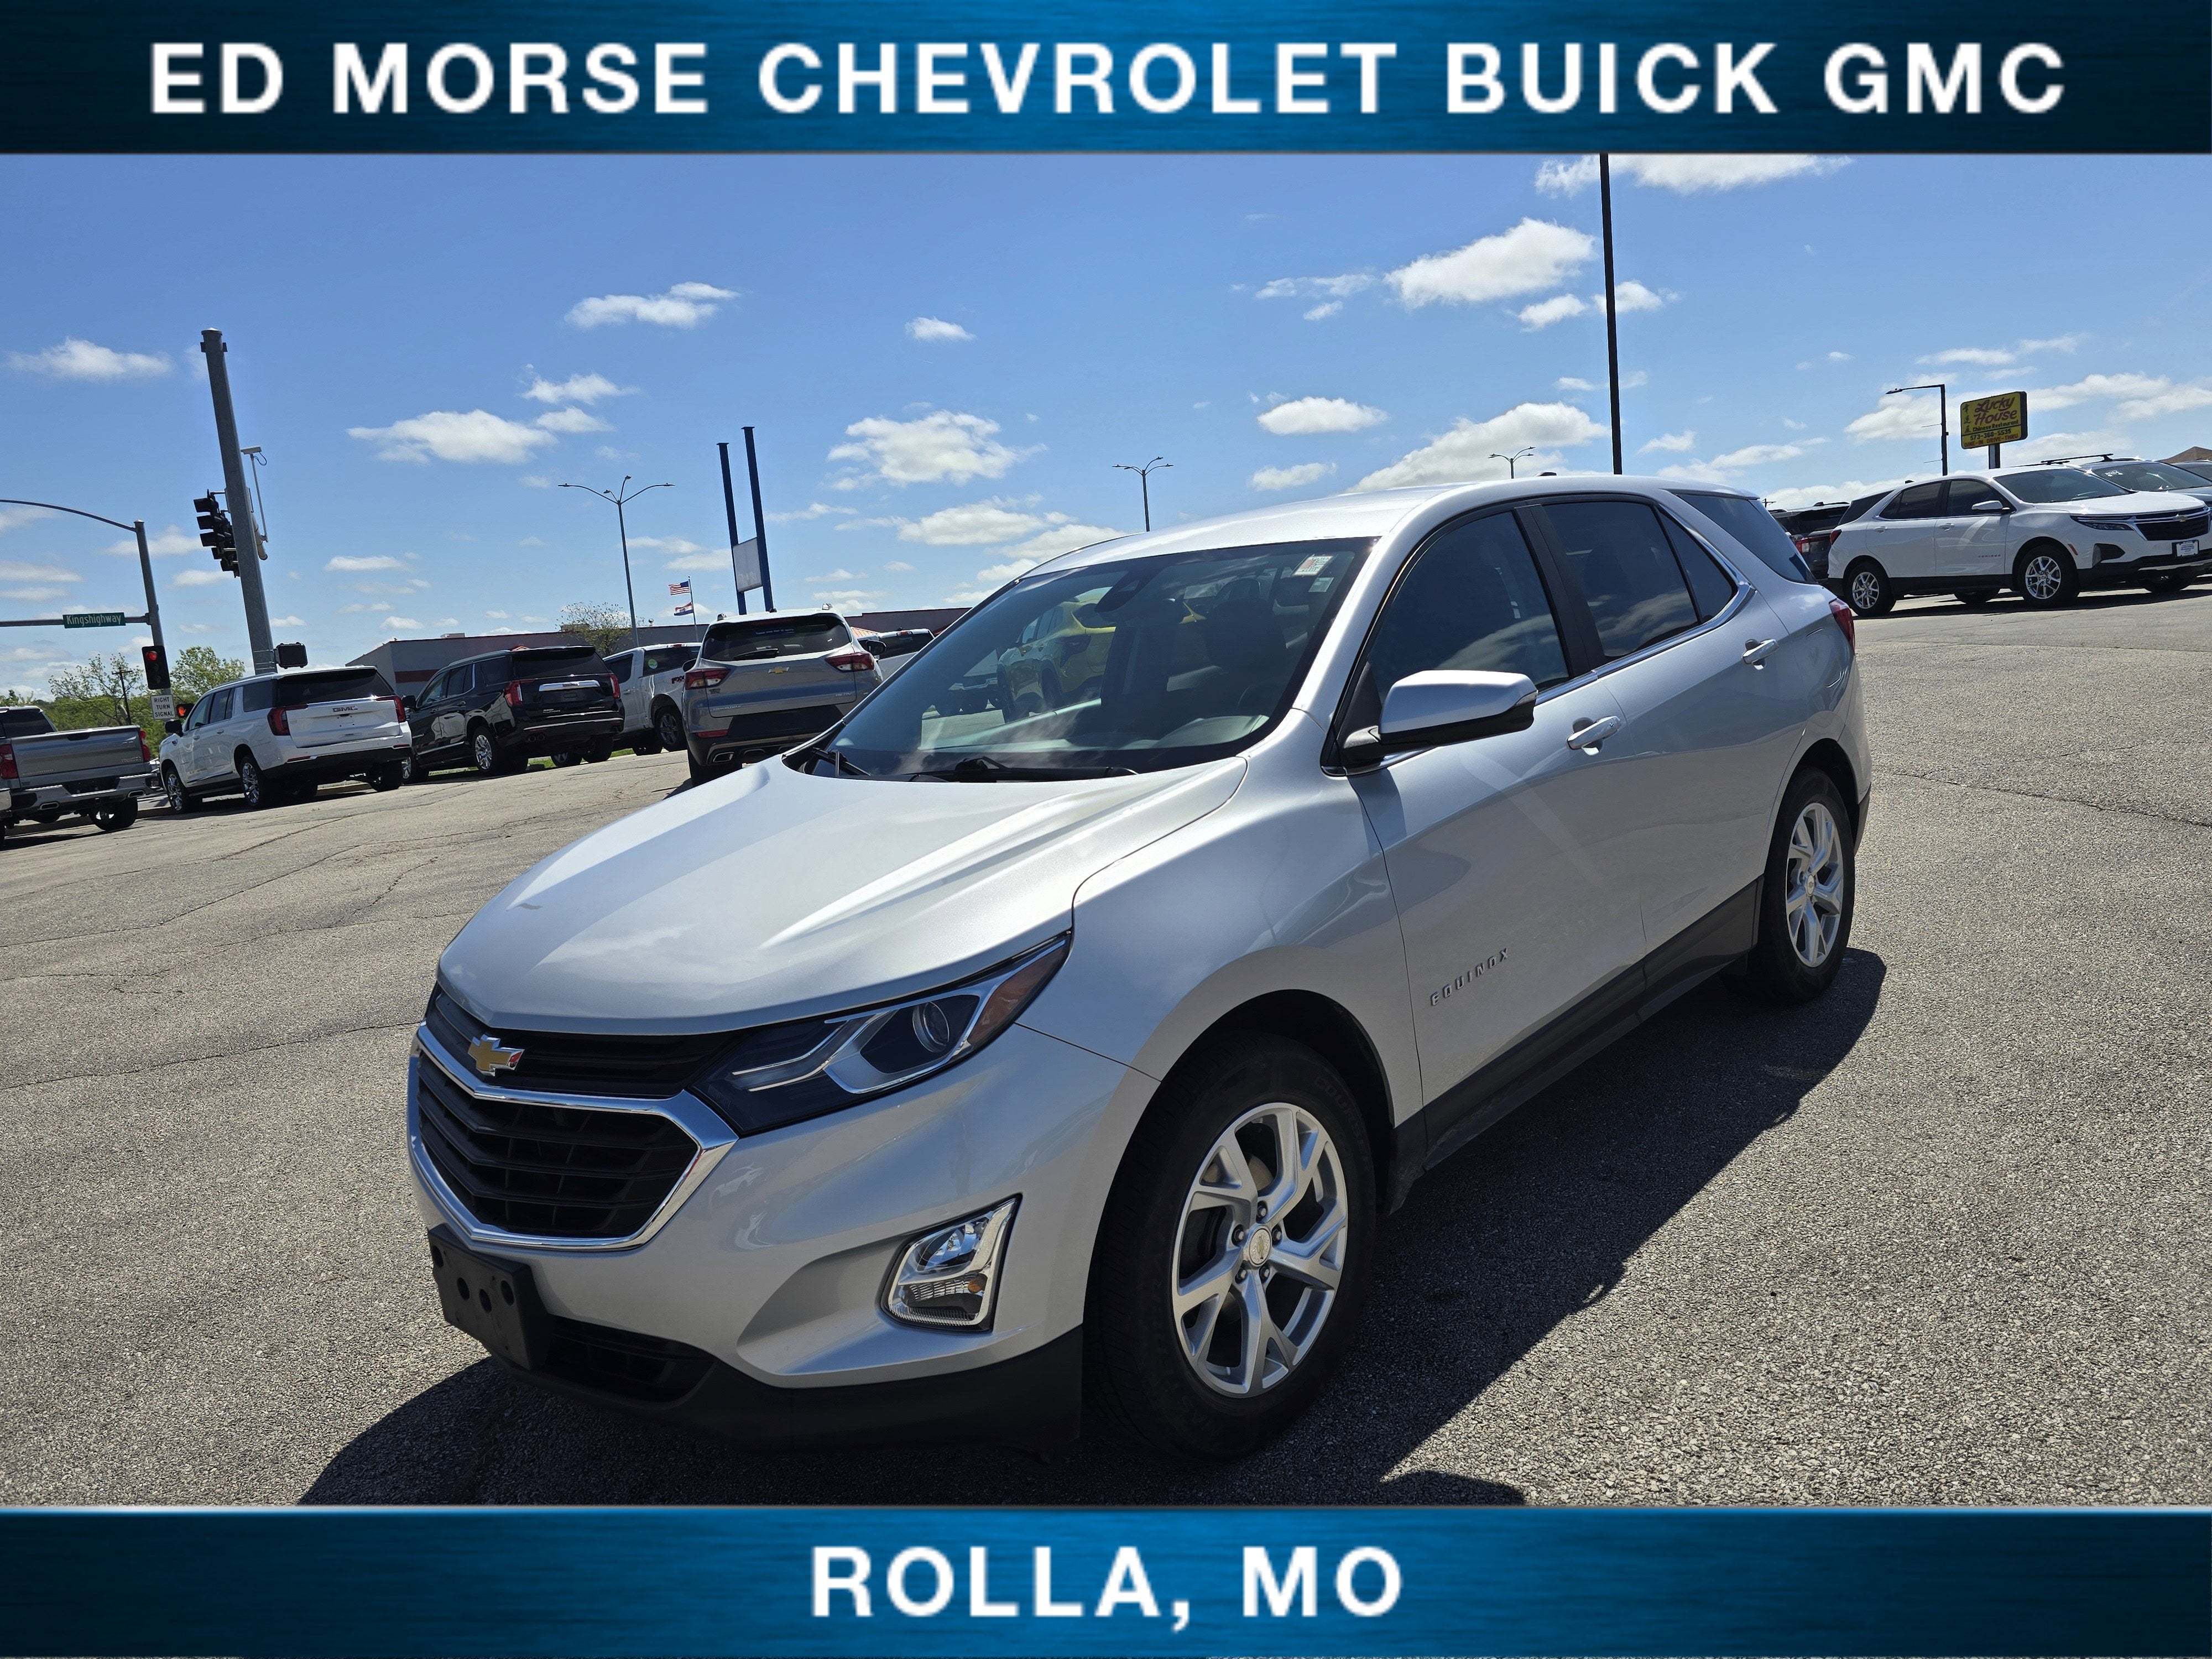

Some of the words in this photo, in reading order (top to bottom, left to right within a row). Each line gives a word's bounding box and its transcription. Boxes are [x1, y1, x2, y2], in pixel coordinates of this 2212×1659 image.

[1974, 397, 2015, 413] Lucky
[1973, 410, 2017, 425] House
[1992, 420, 2018, 428] Restaurant
[1986, 434, 2018, 443] DRIVE-THRU
[66, 614, 122, 627] Kingshighway
[1431, 948, 1509, 1006] EQUINOX
